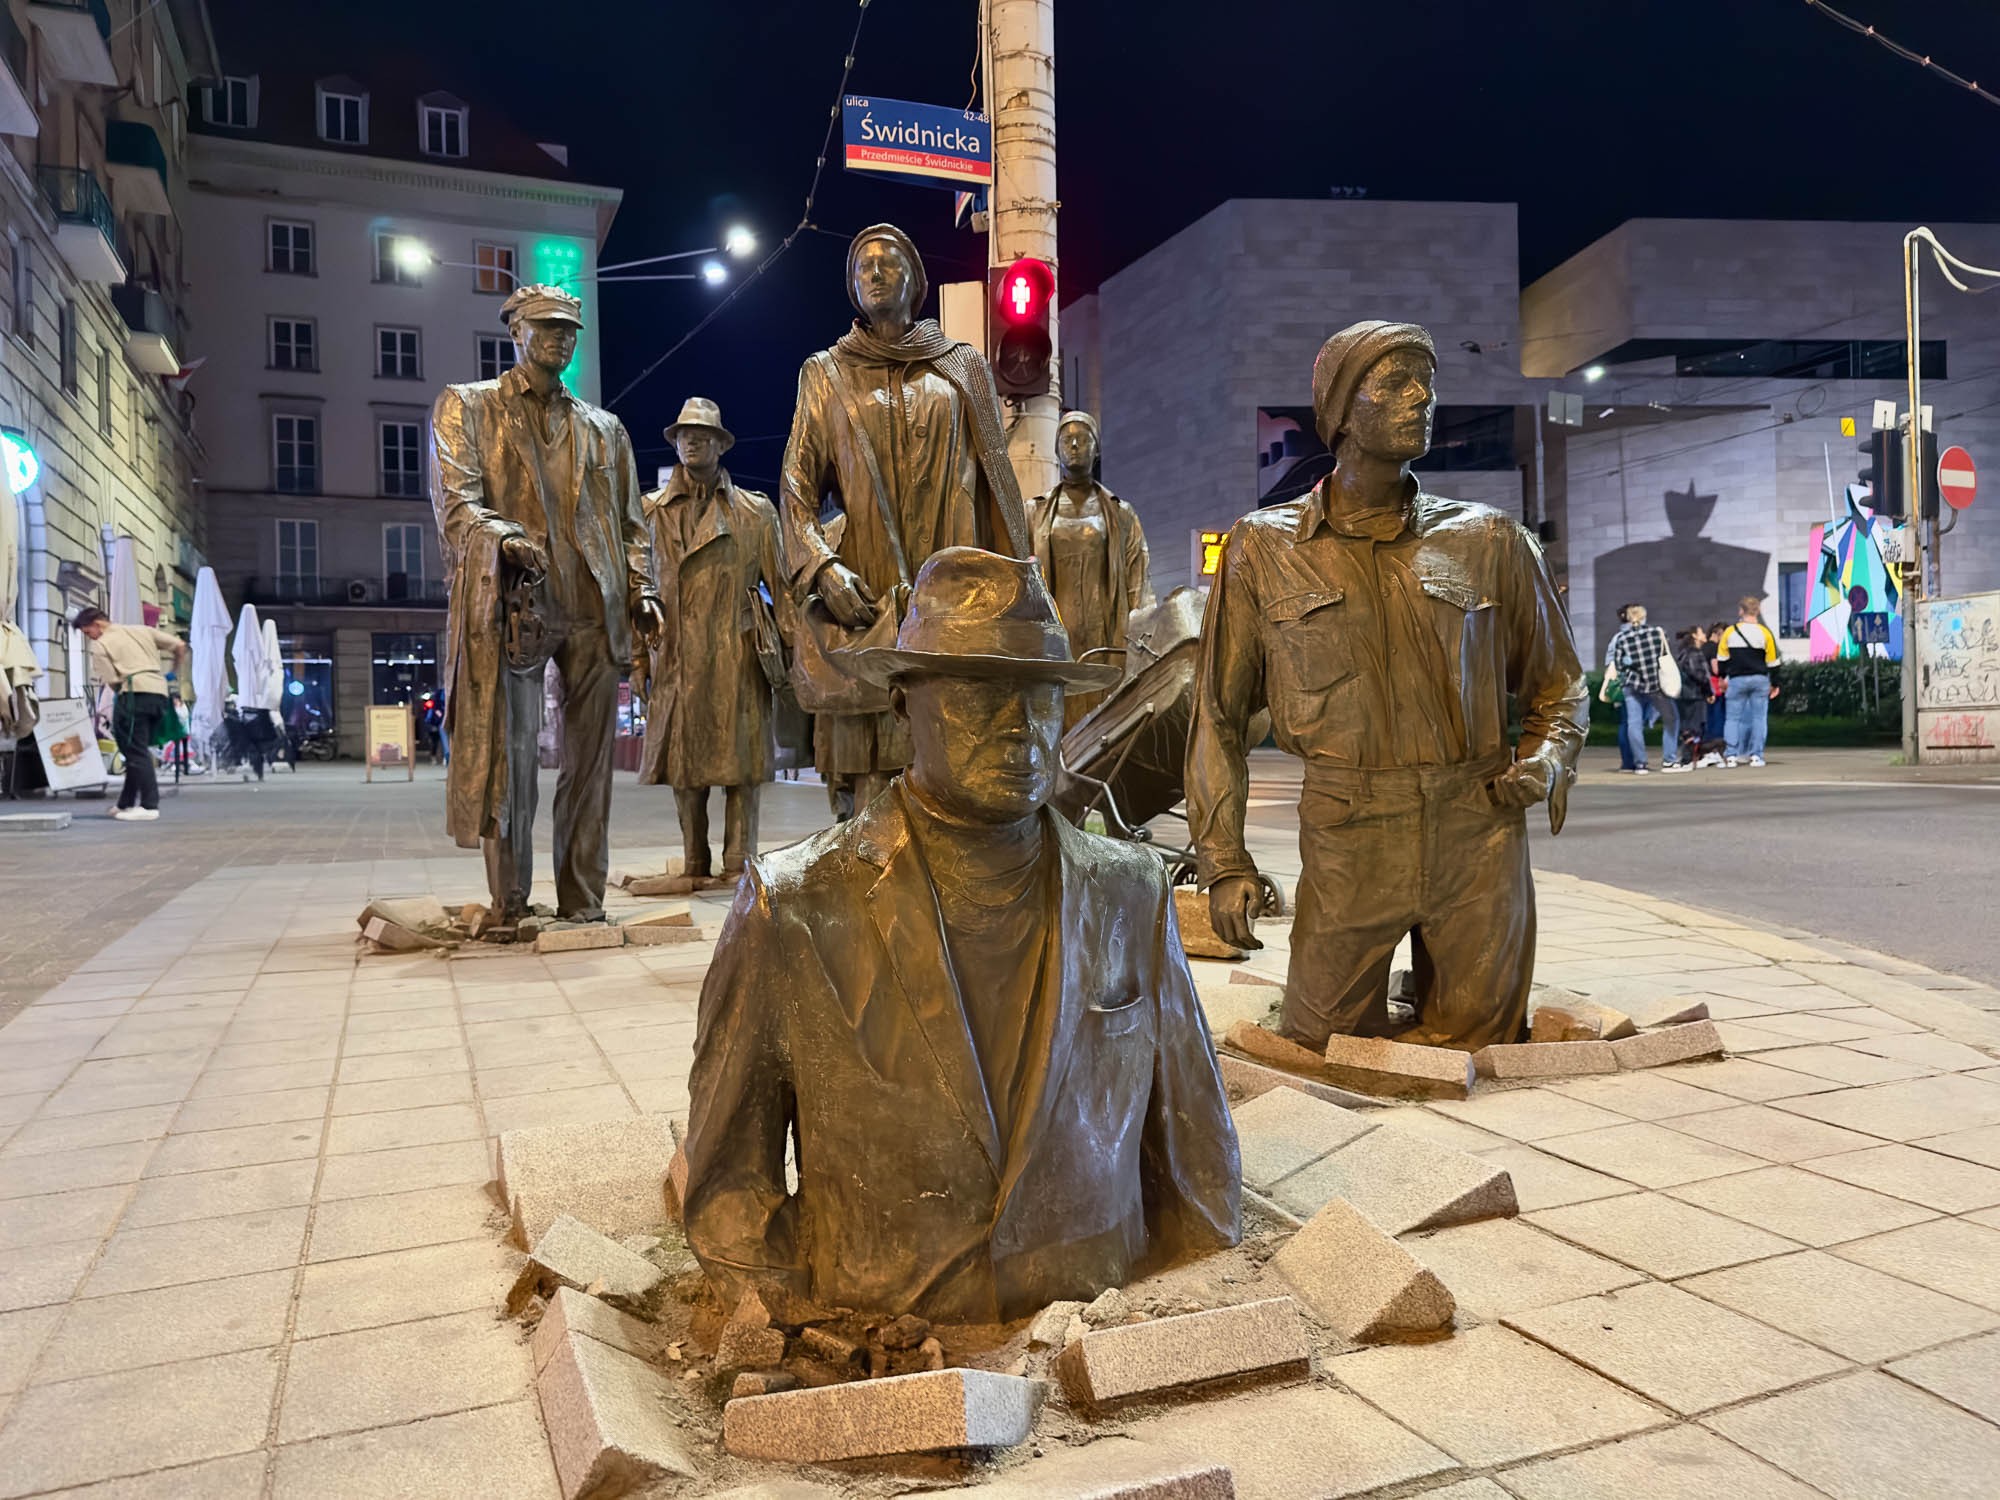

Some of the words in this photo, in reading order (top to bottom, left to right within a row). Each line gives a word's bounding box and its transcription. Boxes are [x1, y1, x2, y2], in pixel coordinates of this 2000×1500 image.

[845, 96, 869, 108] ulica
[963, 111, 990, 124] 42-48
[860, 111, 981, 154] Świdnicka
[861, 148, 923, 165] Przedmieście
[924, 154, 974, 172] Świdnickie
